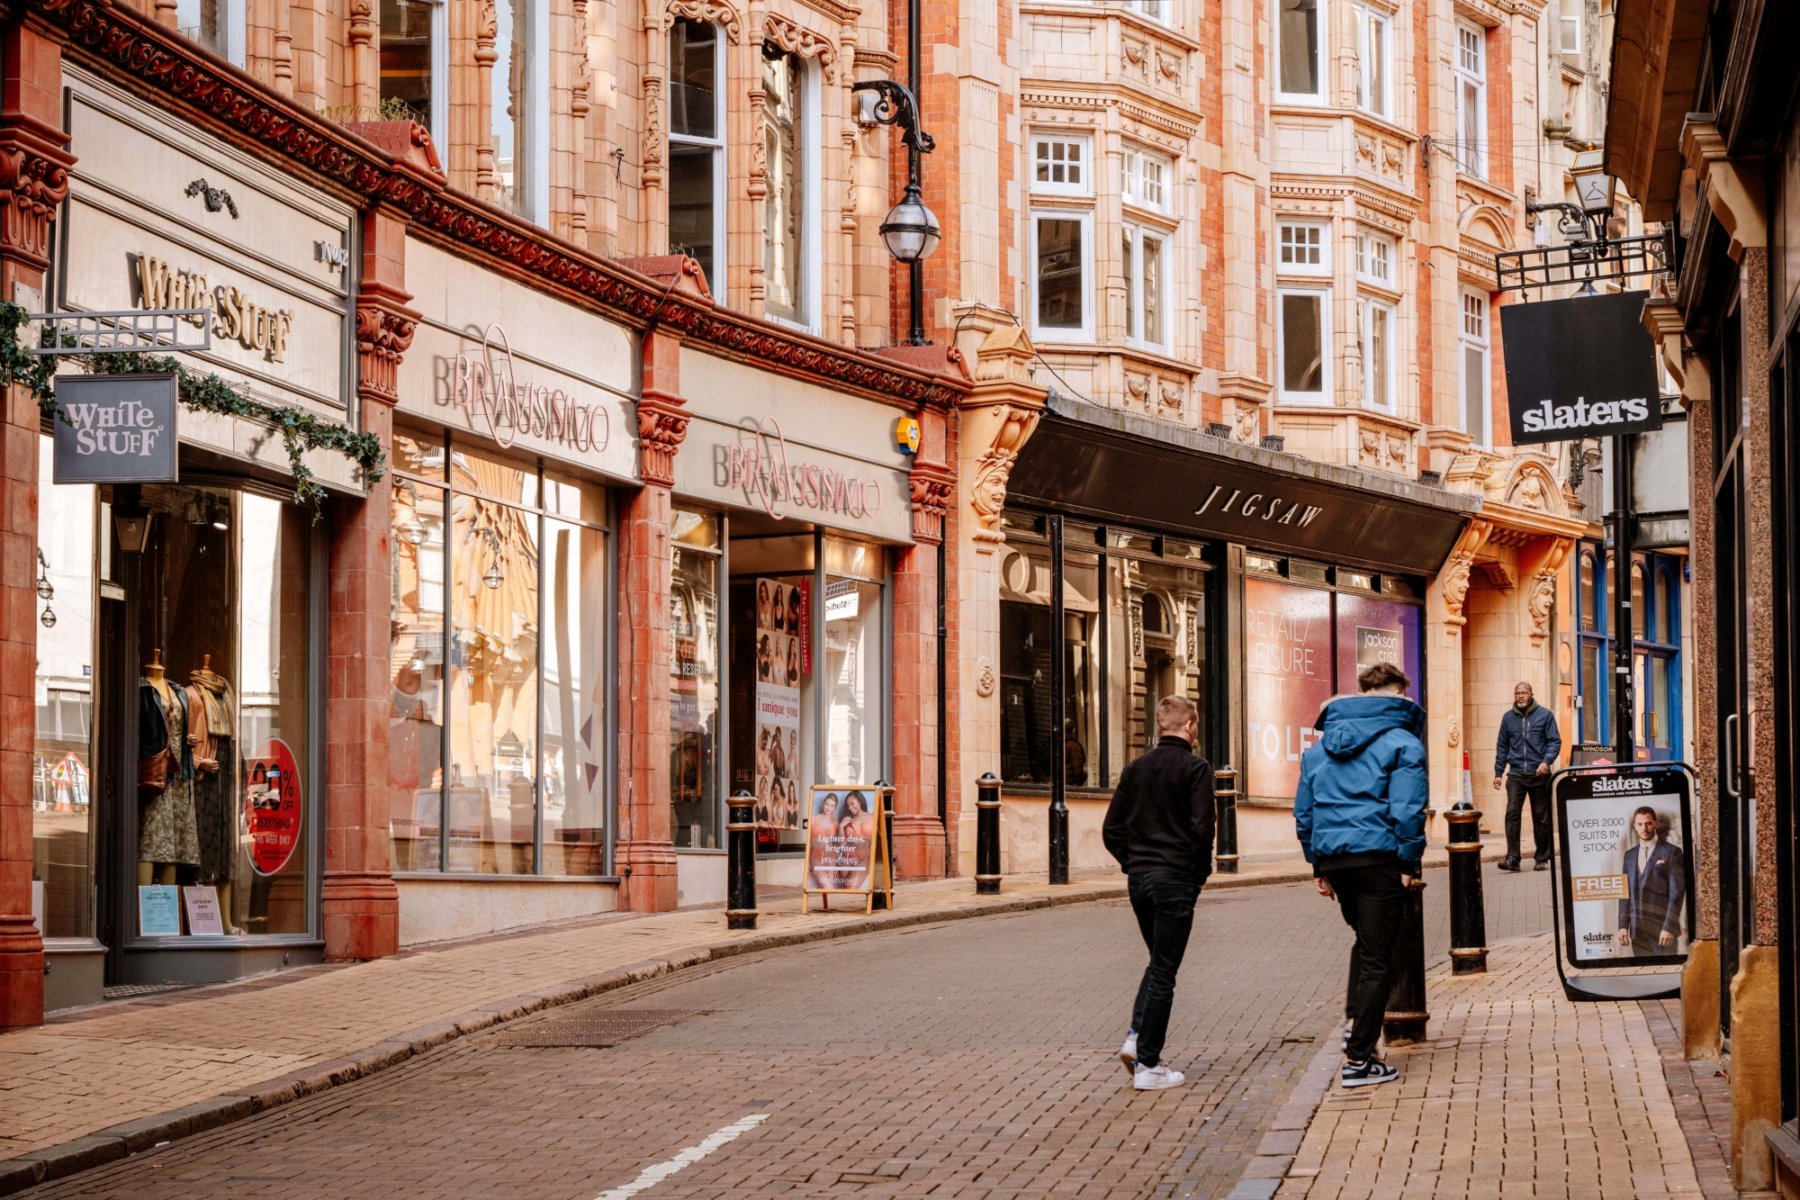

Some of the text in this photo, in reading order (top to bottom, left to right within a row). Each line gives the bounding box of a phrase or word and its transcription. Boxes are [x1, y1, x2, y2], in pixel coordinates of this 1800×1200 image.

[453, 322, 609, 452] BRAVISSIMO
[1522, 396, 1649, 433] slaters
[728, 415, 883, 521] BRAVISSIMO
[1195, 485, 1324, 529] JIGSAW
[1364, 631, 1398, 650] jackson
[1248, 642, 1315, 675] LEISURE
[1378, 650, 1398, 664] criss
[1248, 722, 1281, 761] TO
[1592, 775, 1653, 793] slaters
[1572, 817, 1625, 829] OVER 2000
[1579, 830, 1620, 841] SUITS IN
[825, 844, 857, 853] brighter
[1583, 842, 1617, 853] STOCK
[1576, 876, 1623, 890] FREE
[1583, 932, 1614, 943] slater
